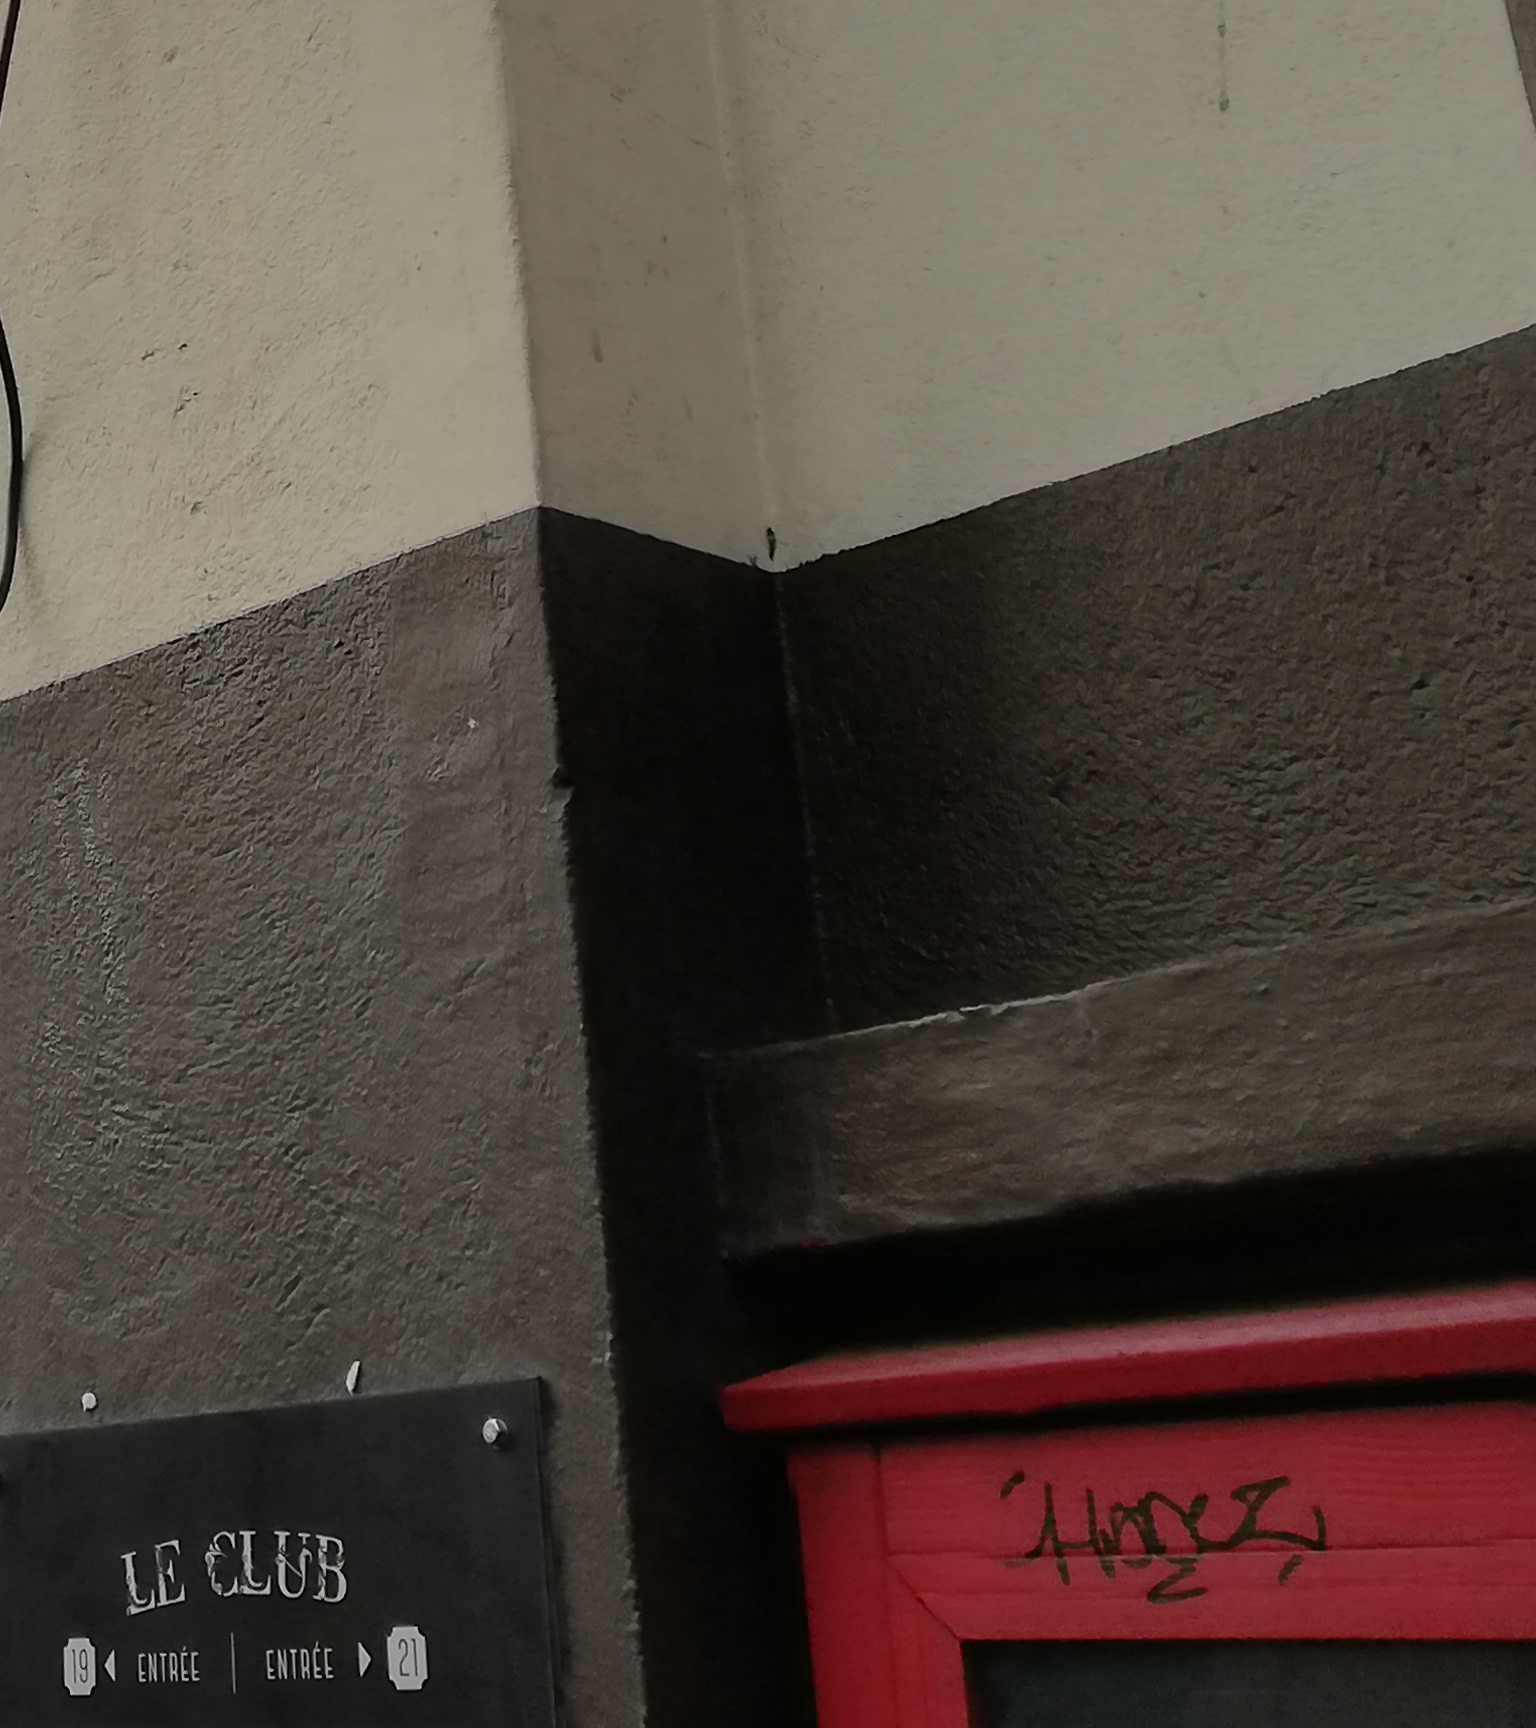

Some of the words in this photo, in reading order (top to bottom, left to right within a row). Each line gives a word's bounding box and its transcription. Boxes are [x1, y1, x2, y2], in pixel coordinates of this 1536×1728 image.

[120, 1539, 186, 1617] LE
[204, 1530, 348, 1604] CLUB
[70, 1648, 89, 1685] 19
[137, 1646, 201, 1684] ENTRÉE
[265, 1640, 335, 1681] ENTRÉE
[397, 1637, 420, 1678] 21
